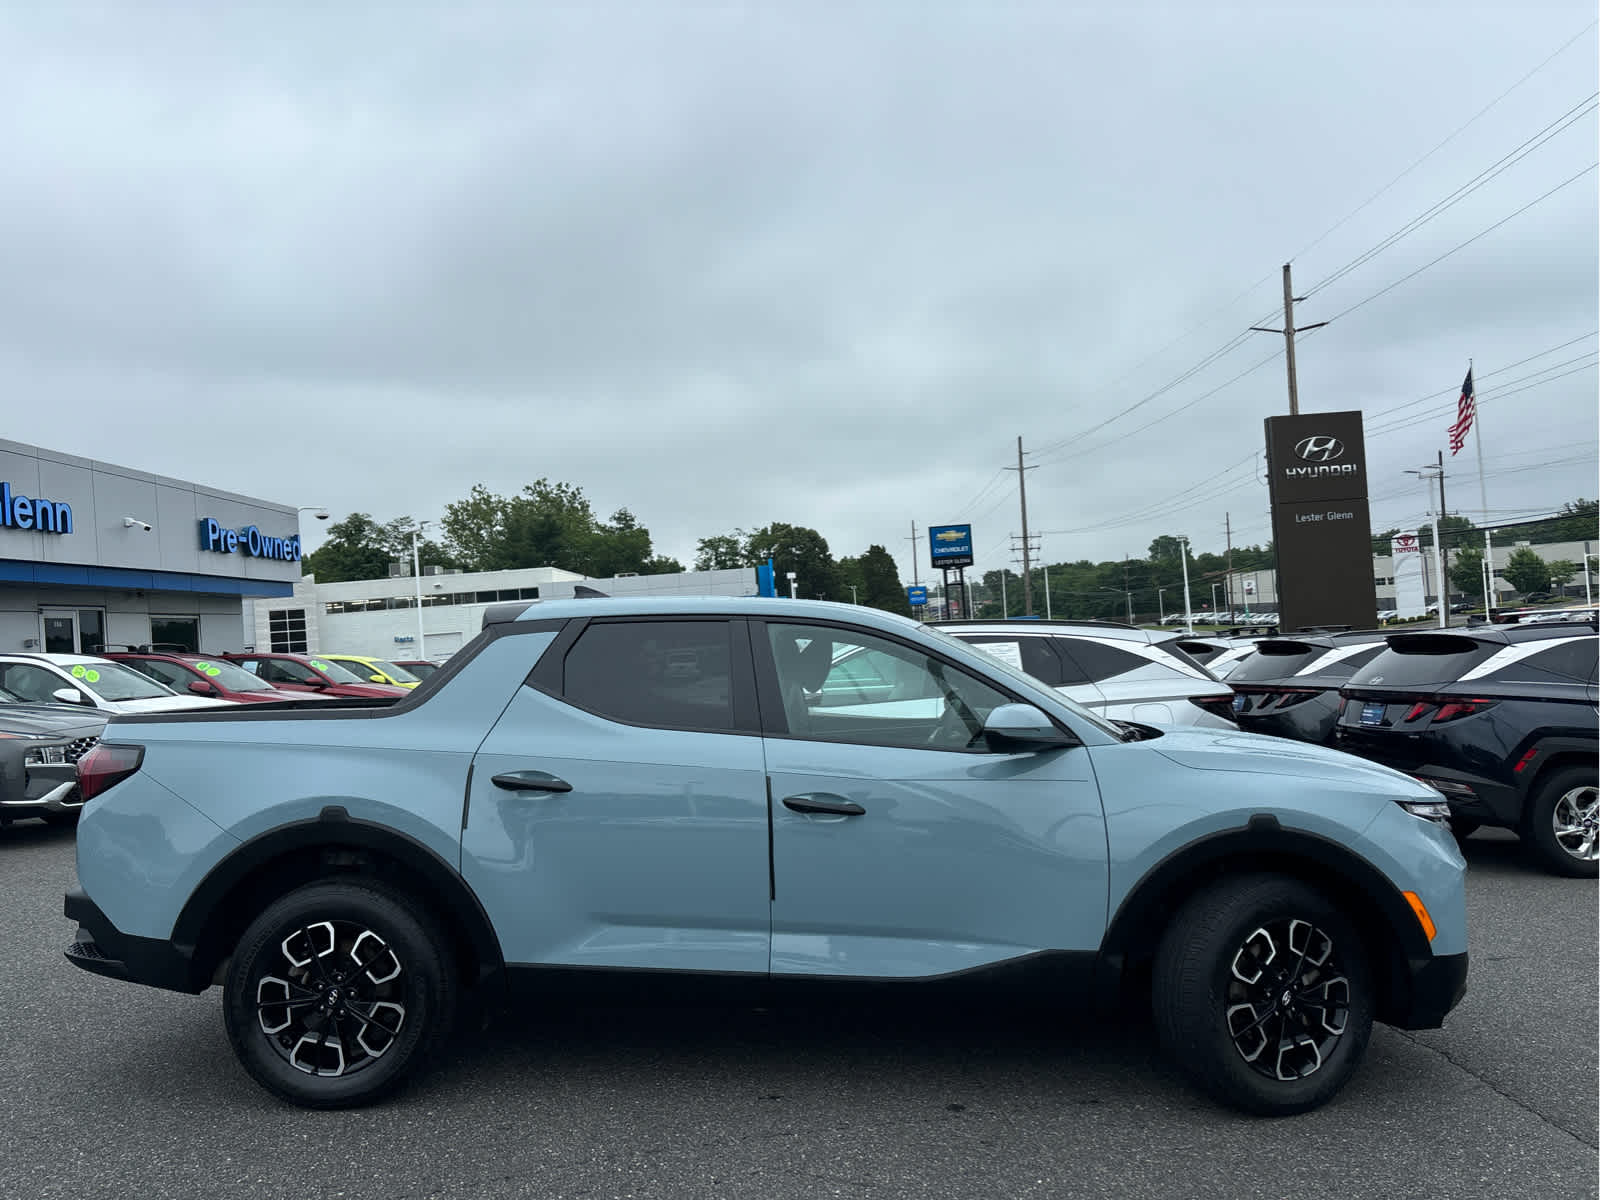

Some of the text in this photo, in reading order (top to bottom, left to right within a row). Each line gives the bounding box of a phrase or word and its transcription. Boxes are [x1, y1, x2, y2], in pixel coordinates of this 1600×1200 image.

[1286, 464, 1357, 479] HYUNDAI
[0, 482, 73, 534] lenn
[1295, 511, 1353, 523] Lester Glenn
[201, 518, 301, 561] Pre-Owned
